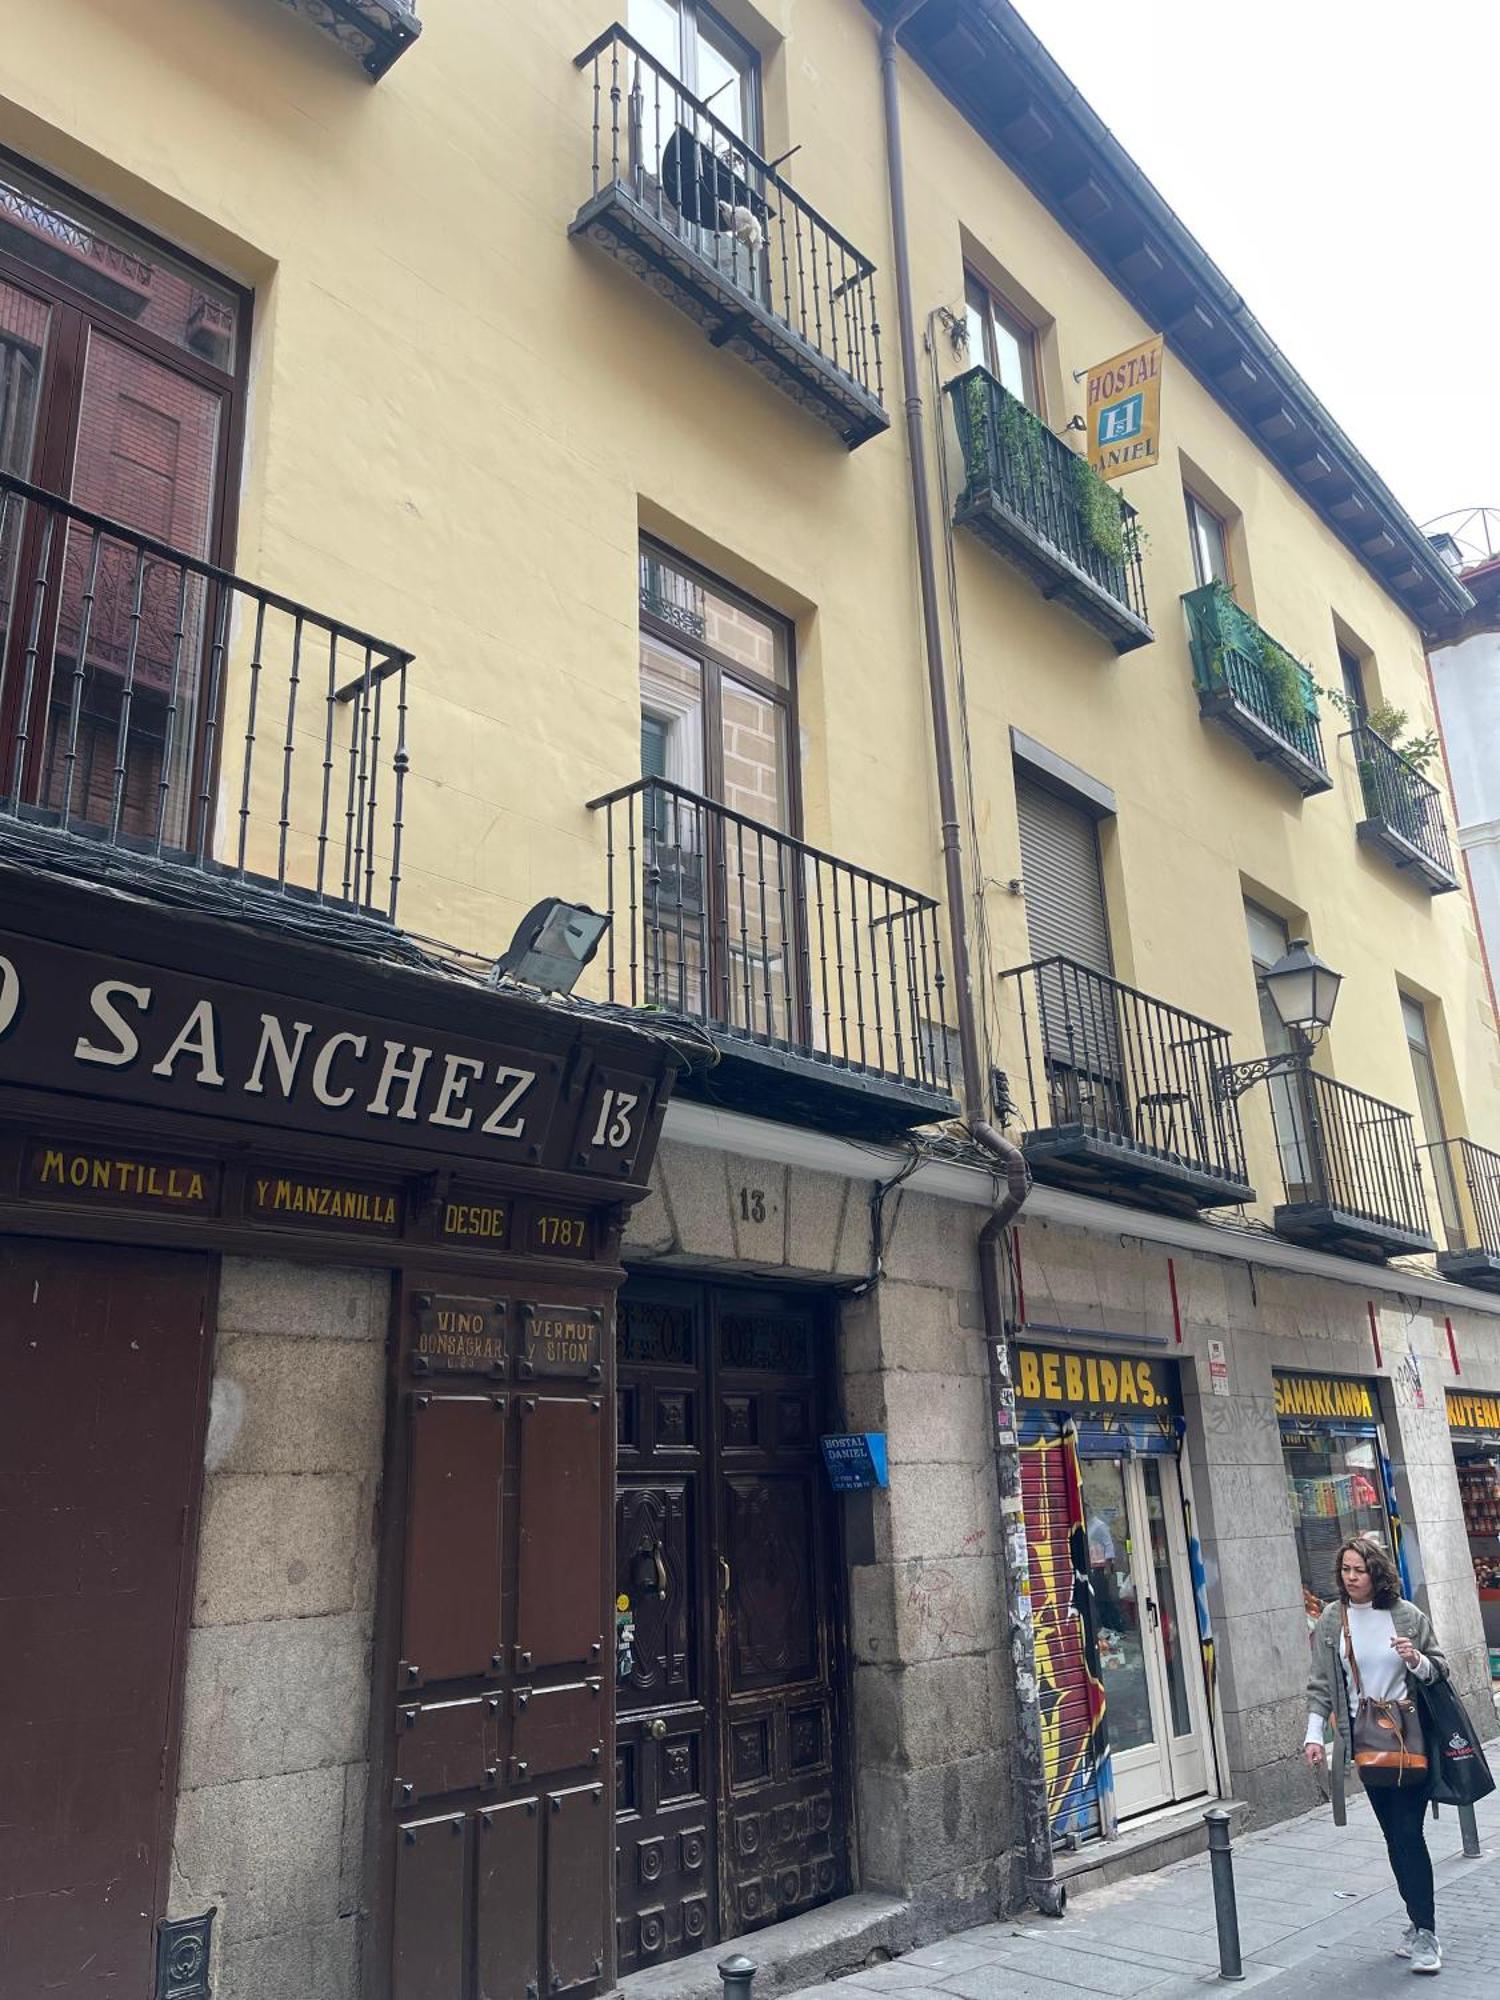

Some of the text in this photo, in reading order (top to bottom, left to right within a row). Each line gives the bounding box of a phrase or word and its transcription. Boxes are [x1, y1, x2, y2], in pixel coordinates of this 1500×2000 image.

[1088, 350, 1158, 406] HOSTAL
[74, 980, 537, 1138] SANCHEZ
[591, 1088, 638, 1149] 13
[41, 1149, 204, 1200] MONTILLA
[273, 1179, 396, 1225] MANZANILLA
[739, 1186, 767, 1224] 13
[444, 1203, 503, 1238] DESDE
[536, 1216, 586, 1248] 1787
[436, 1311, 485, 1334] VINO
[531, 1319, 596, 1341] VERMUT
[546, 1341, 589, 1362] SIFON
[1272, 1376, 1373, 1418] SAMARKANDA
[824, 1437, 865, 1449] HOSTAL
[828, 1449, 867, 1460] DANIEL
